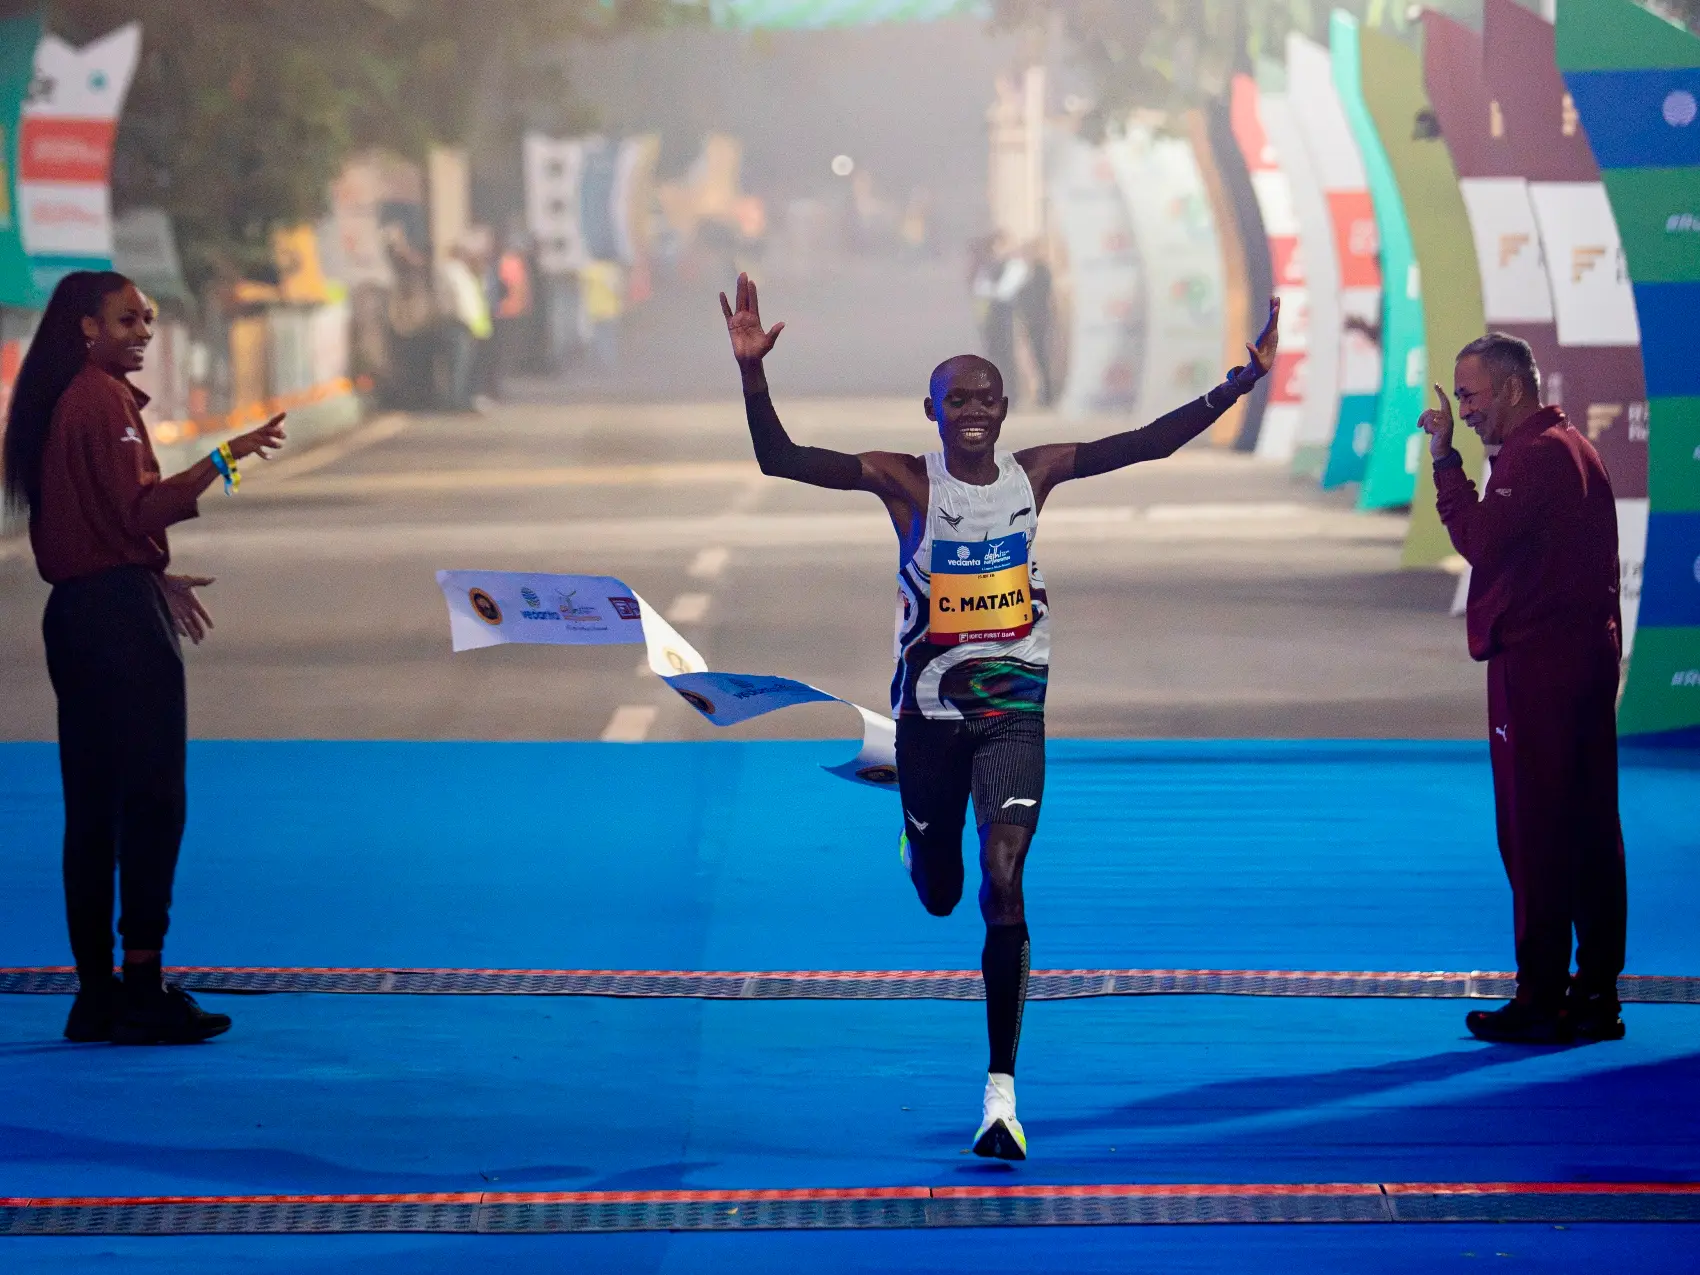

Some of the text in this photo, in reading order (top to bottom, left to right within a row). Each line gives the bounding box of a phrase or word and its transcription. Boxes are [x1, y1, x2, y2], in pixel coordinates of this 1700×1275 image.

[948, 558, 981, 567] vedanta
[939, 589, 1025, 613] C. MATATA
